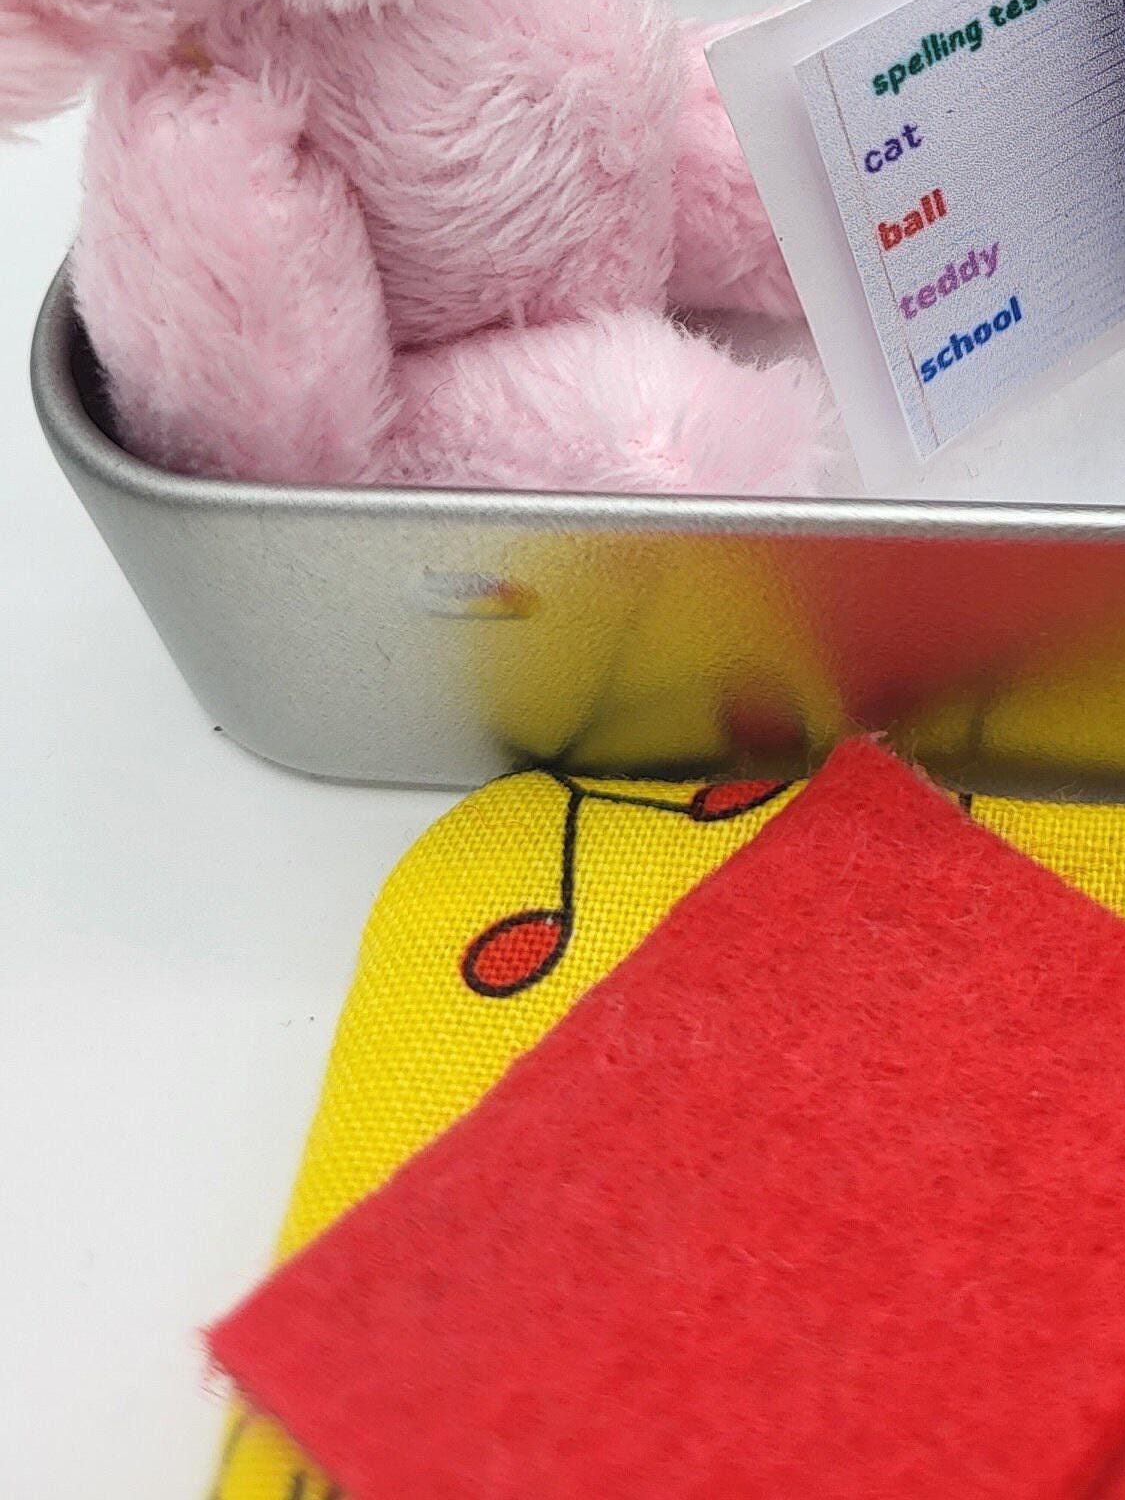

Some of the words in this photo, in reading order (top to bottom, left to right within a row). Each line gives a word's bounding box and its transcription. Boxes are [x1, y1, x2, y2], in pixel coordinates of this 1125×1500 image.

[873, 17, 984, 96] spelling
[864, 123, 924, 174] cat
[878, 188, 948, 252] ball
[898, 242, 1001, 320] teddy
[920, 296, 1023, 384] school
